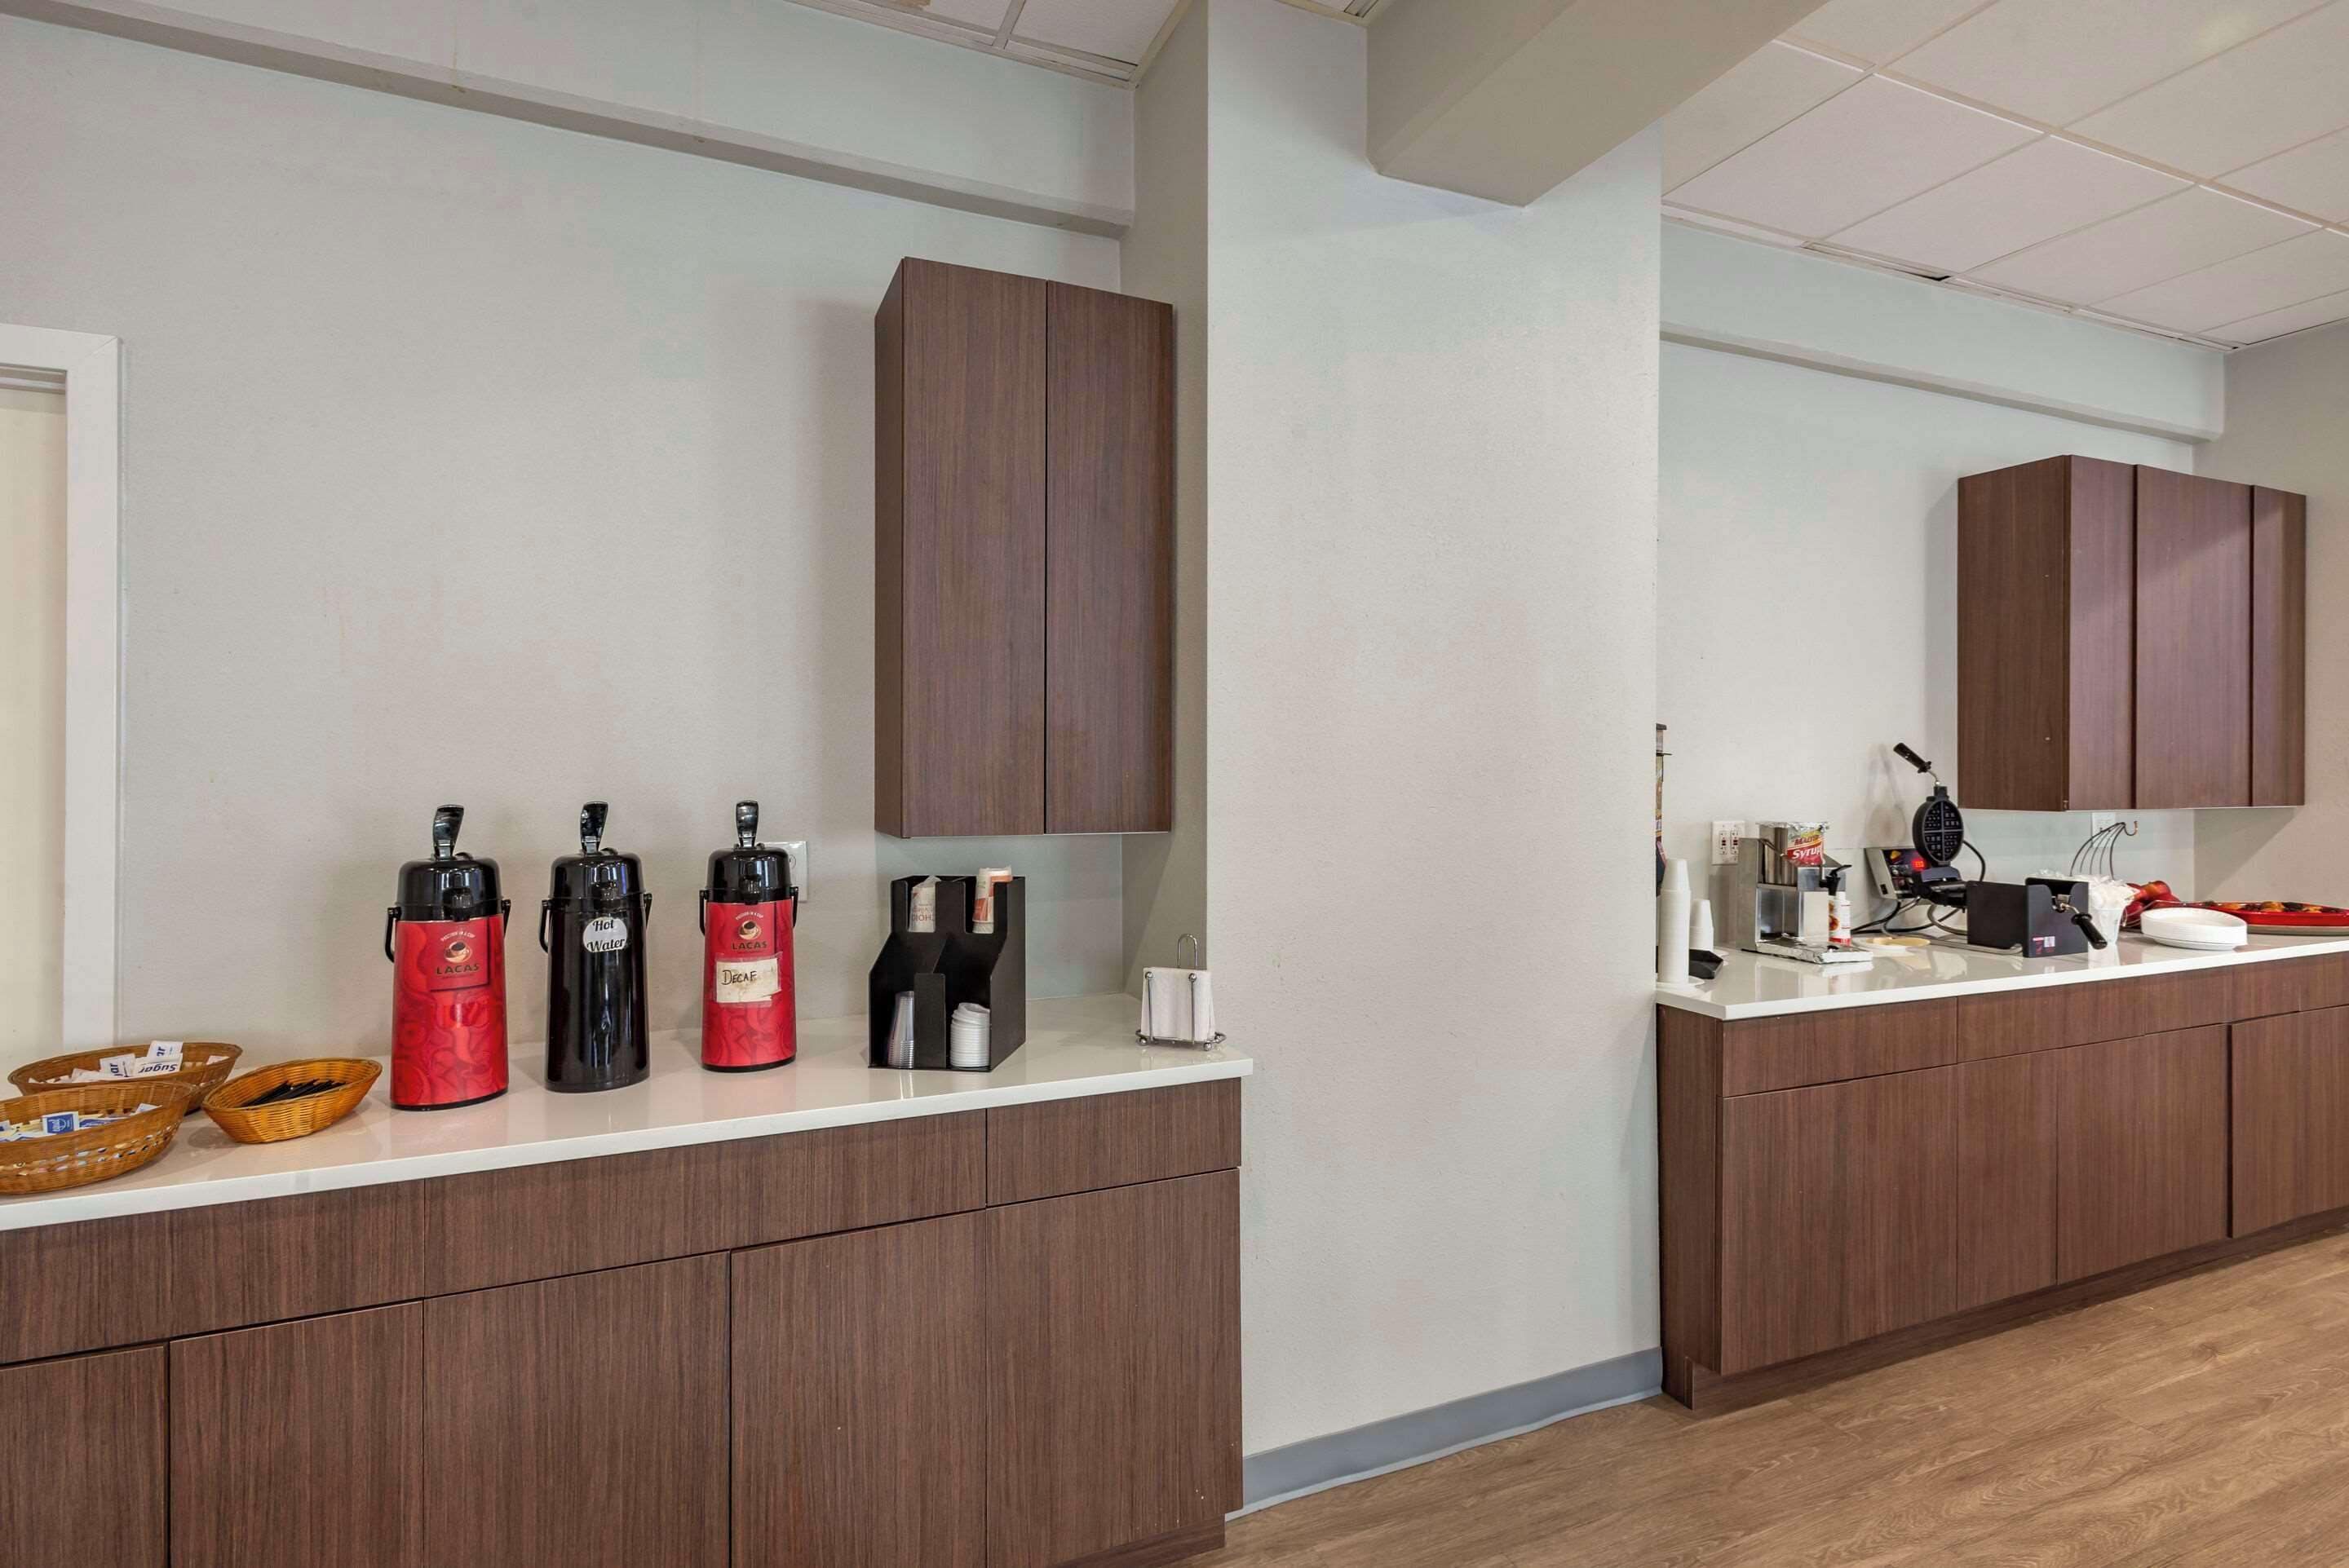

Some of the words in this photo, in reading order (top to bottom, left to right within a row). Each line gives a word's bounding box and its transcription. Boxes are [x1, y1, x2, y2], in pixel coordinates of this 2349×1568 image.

[593, 920, 614, 931] Hot
[586, 939, 625, 952] Water
[732, 941, 768, 950] LACAS
[436, 964, 480, 974] LACAS
[721, 970, 757, 985] DECAF
[138, 1063, 178, 1073] Sugar
